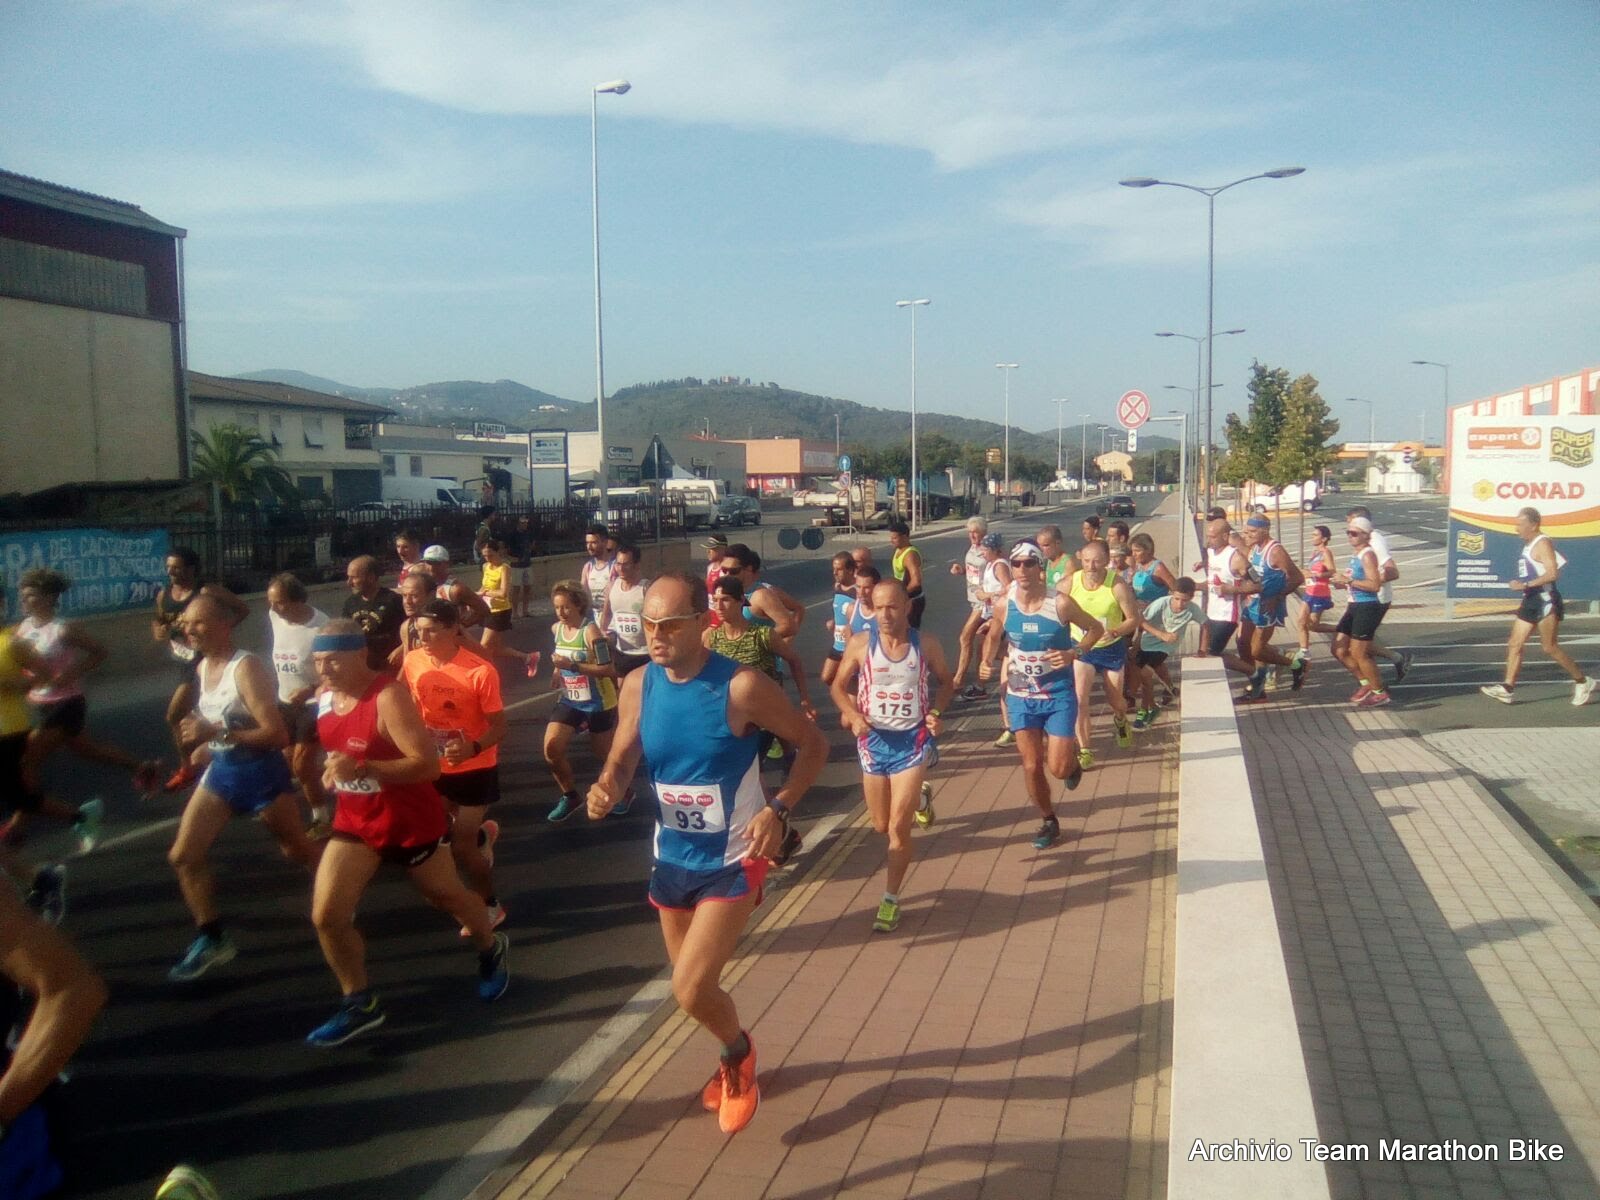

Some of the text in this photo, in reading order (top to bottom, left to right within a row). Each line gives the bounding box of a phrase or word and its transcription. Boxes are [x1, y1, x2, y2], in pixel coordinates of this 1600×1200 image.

[1552, 427, 1593, 445] SUPER
[1552, 442, 1592, 461] CASA
[1496, 482, 1585, 499] CONAD
[49, 537, 76, 560] DEL
[63, 558, 105, 580] DELLA
[618, 624, 638, 633] 186
[275, 662, 298, 674] 148
[1024, 664, 1043, 675] 83
[878, 702, 912, 717] 175
[675, 810, 706, 830] 93
